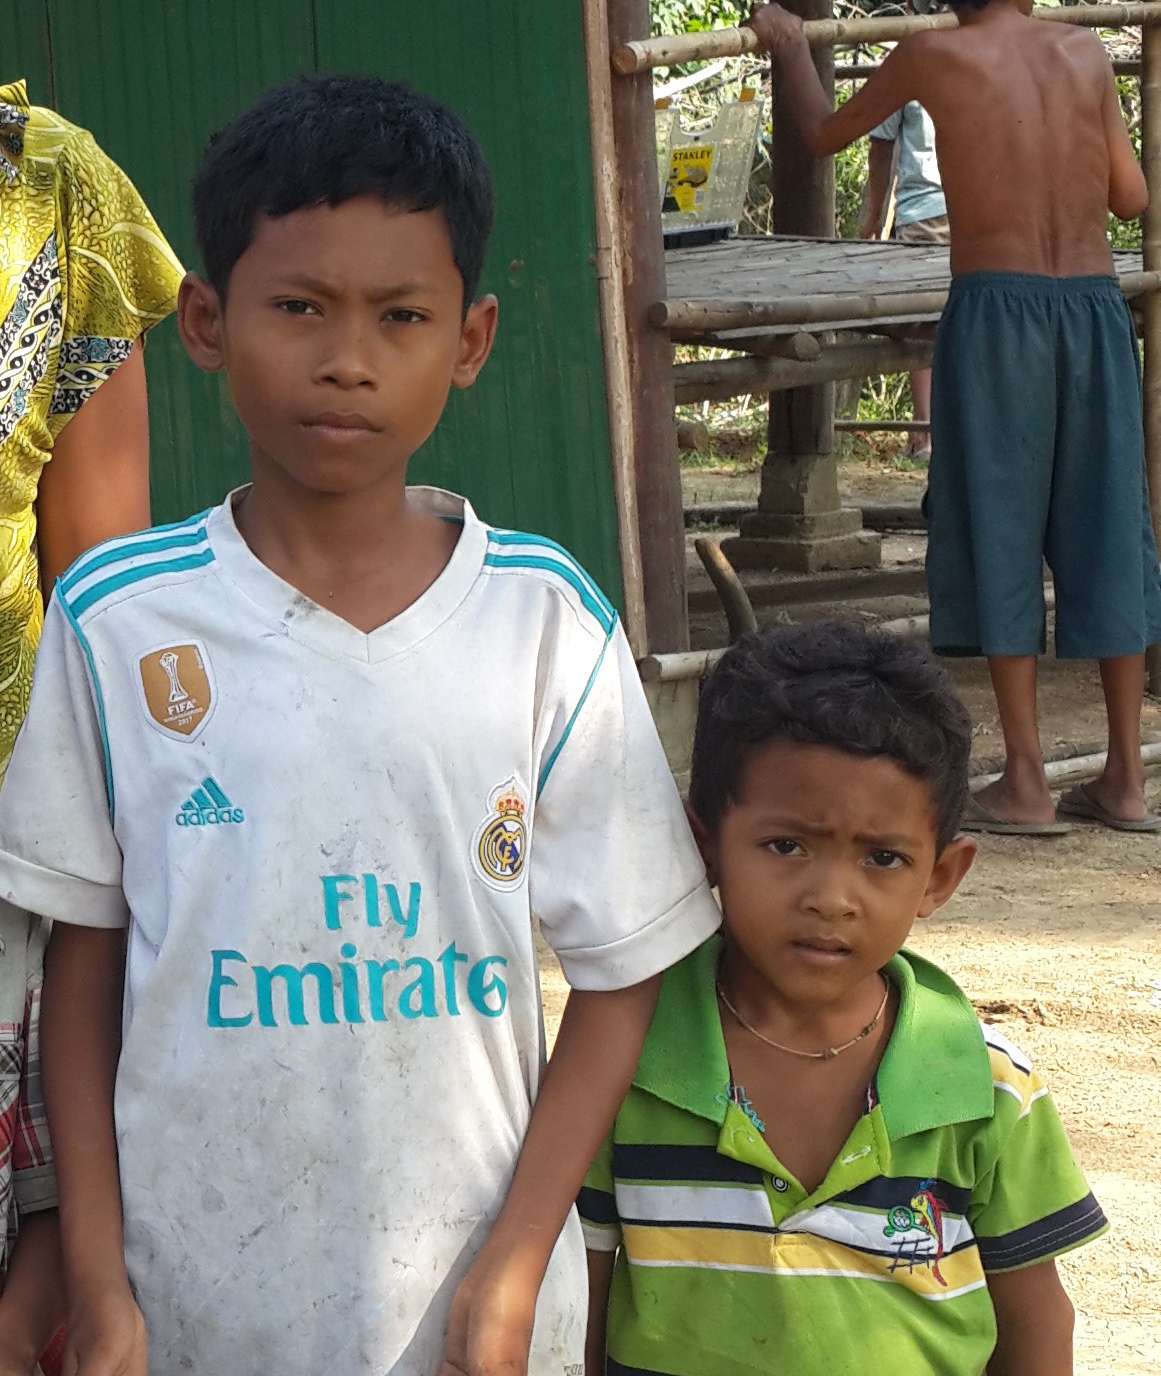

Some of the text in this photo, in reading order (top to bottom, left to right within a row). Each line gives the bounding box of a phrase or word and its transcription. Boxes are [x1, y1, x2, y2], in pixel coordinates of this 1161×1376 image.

[672, 149, 712, 162] STANLEY
[167, 700, 195, 717] FIFA
[175, 807, 245, 827] adidas
[321, 873, 422, 939] Fly
